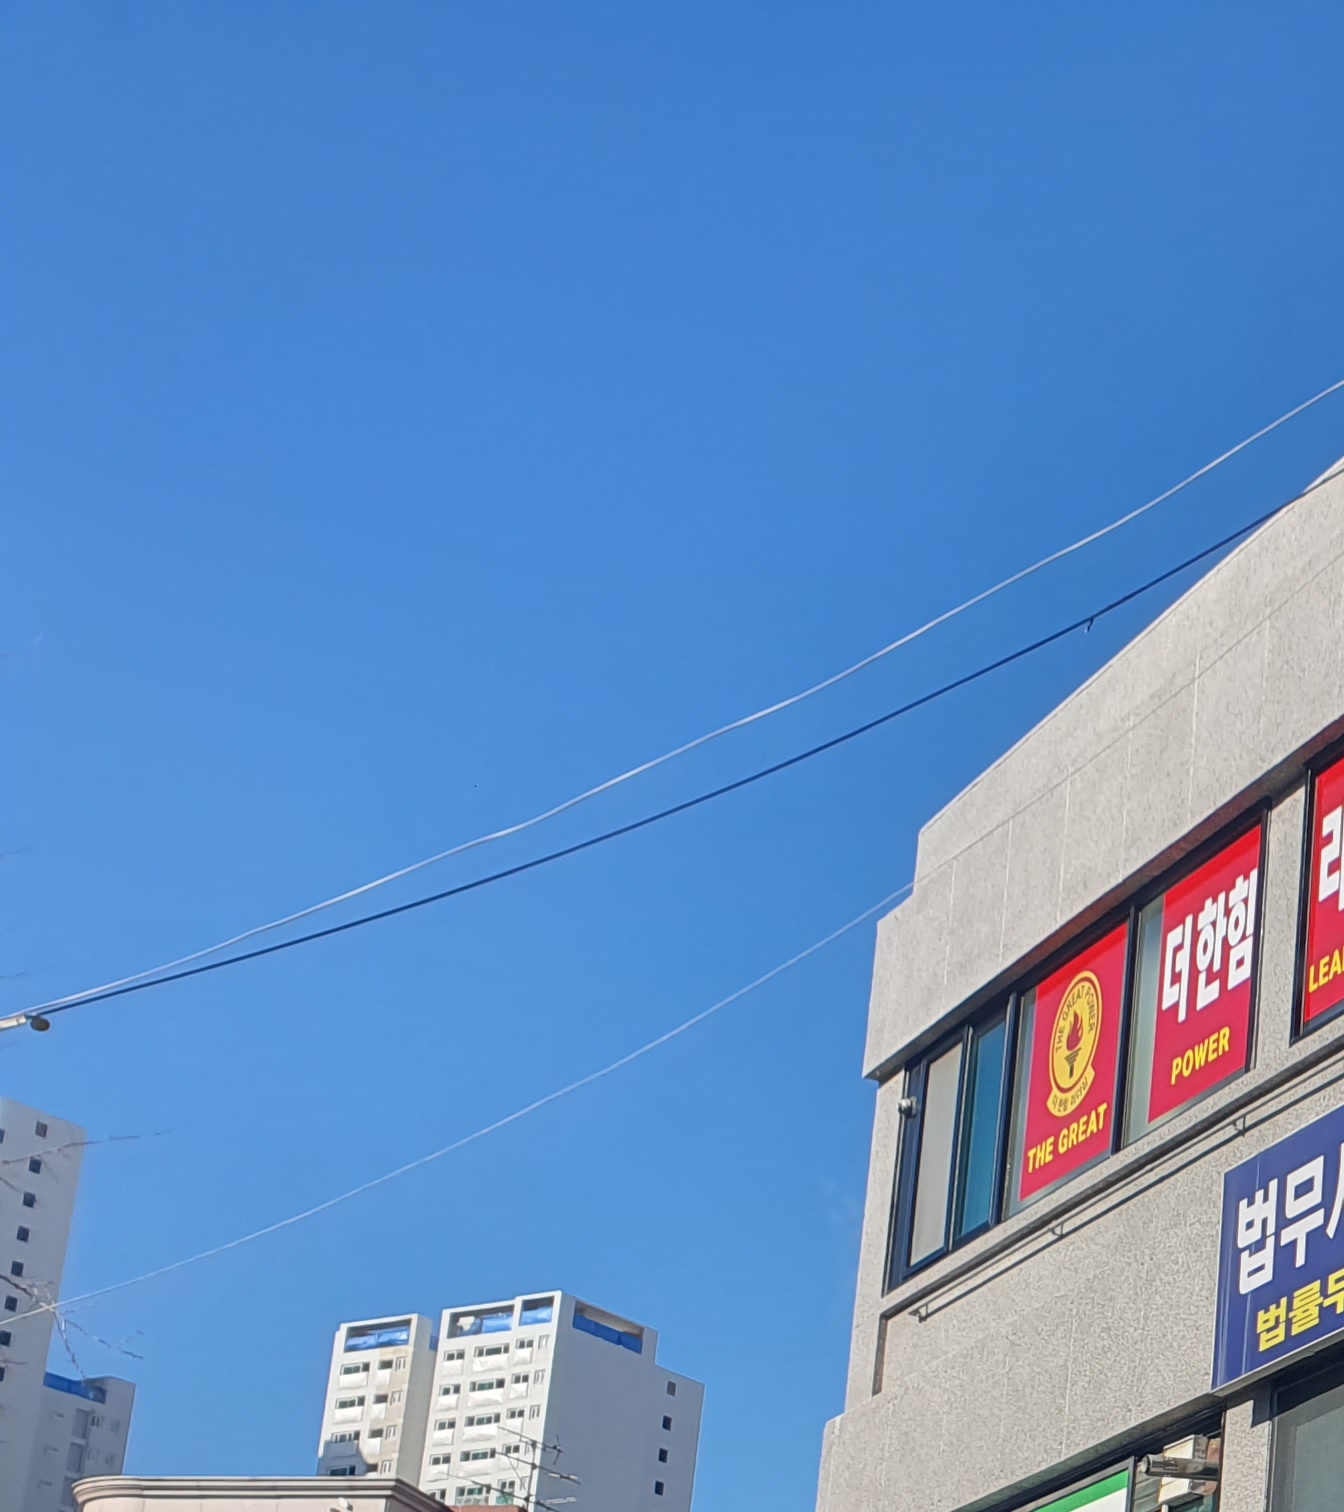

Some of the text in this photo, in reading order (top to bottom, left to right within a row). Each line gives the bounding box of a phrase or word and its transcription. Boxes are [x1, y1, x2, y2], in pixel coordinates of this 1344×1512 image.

[1170, 1026, 1230, 1086] POWER
[1027, 1102, 1107, 1173] THE GREAT
